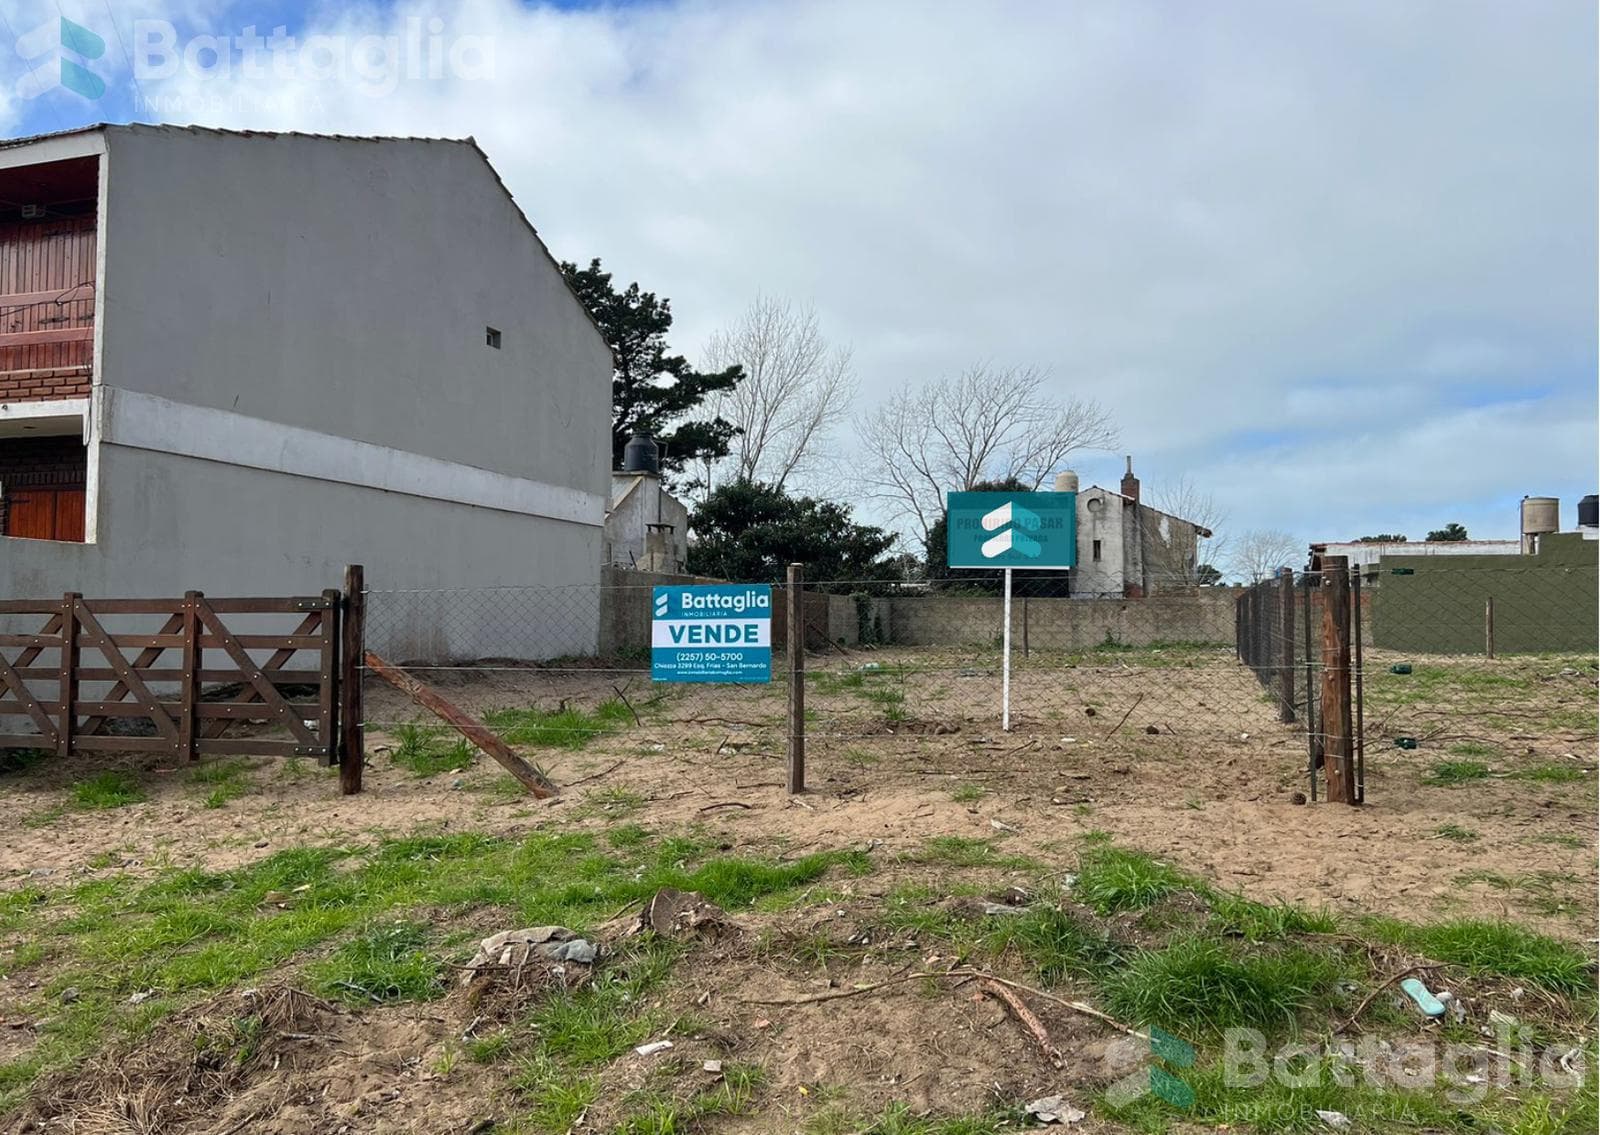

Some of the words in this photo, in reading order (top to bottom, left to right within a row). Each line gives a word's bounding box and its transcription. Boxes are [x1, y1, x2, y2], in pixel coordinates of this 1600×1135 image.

[1025, 517, 1064, 530] PASAR
[681, 590, 769, 613] Battaglia
[668, 624, 759, 644] VENDE
[676, 652, 704, 662] (2257)
[705, 652, 743, 661] 50-5700
